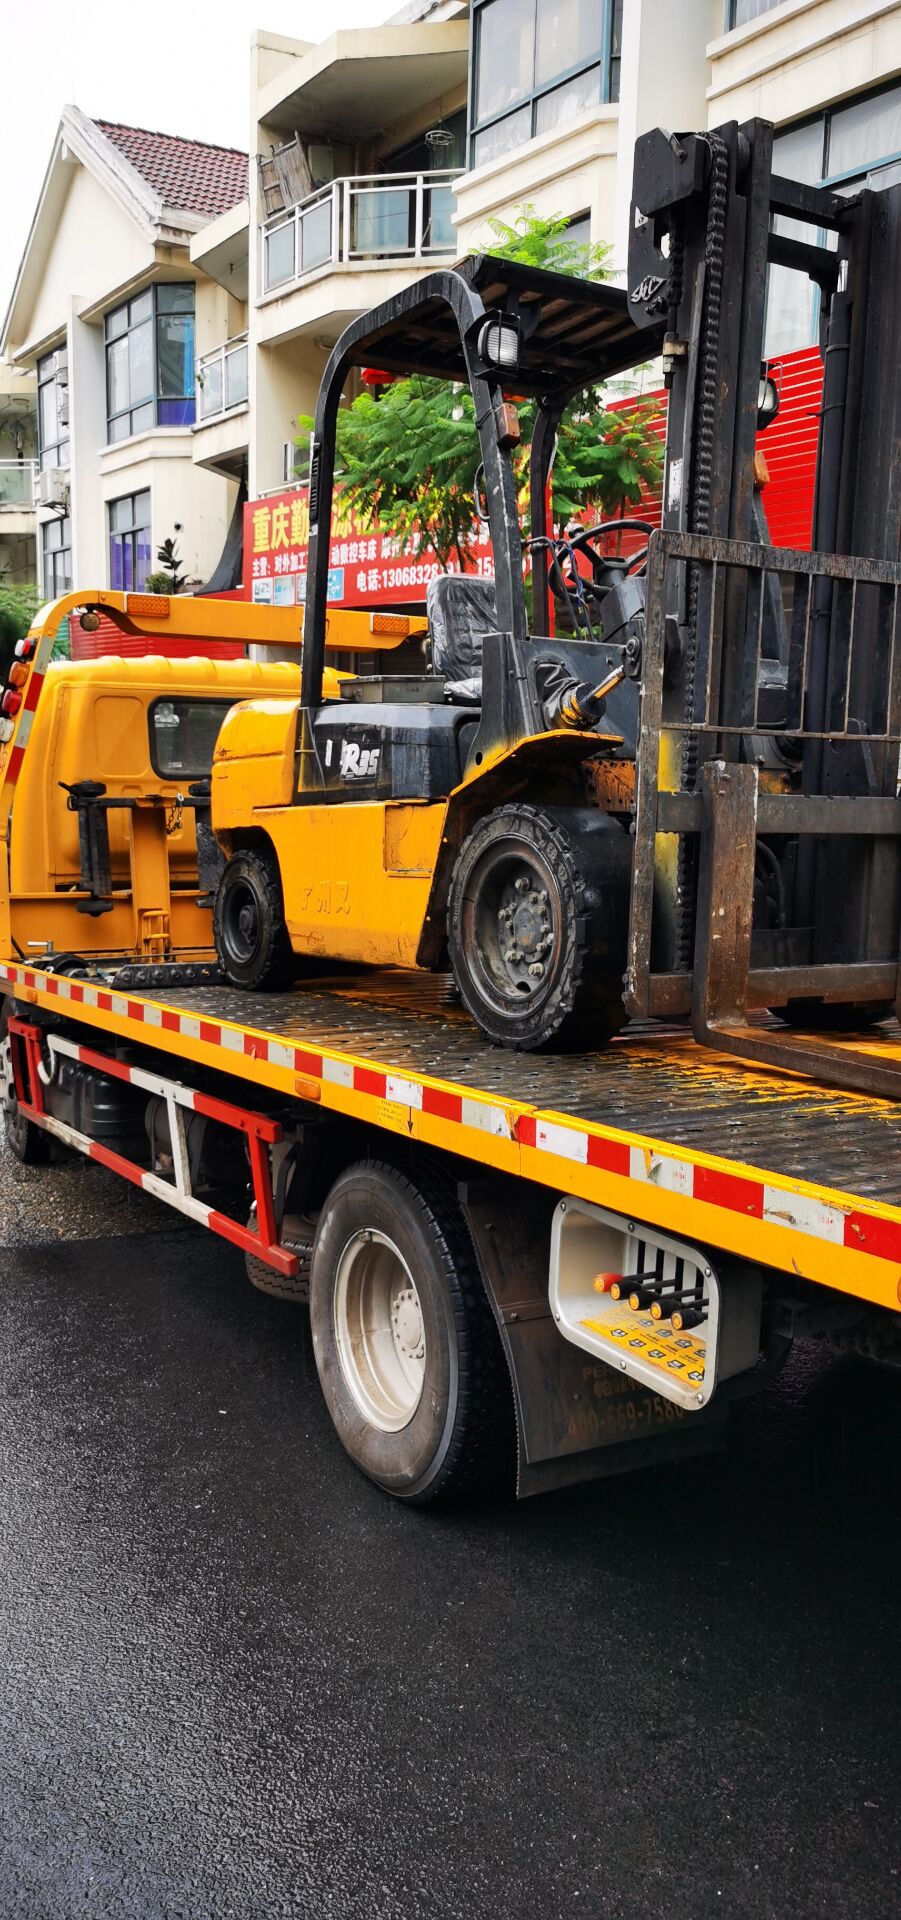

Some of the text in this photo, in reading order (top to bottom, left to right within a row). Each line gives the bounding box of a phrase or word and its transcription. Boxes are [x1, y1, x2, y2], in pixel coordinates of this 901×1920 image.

[331, 538, 377, 566] 动数控车床
